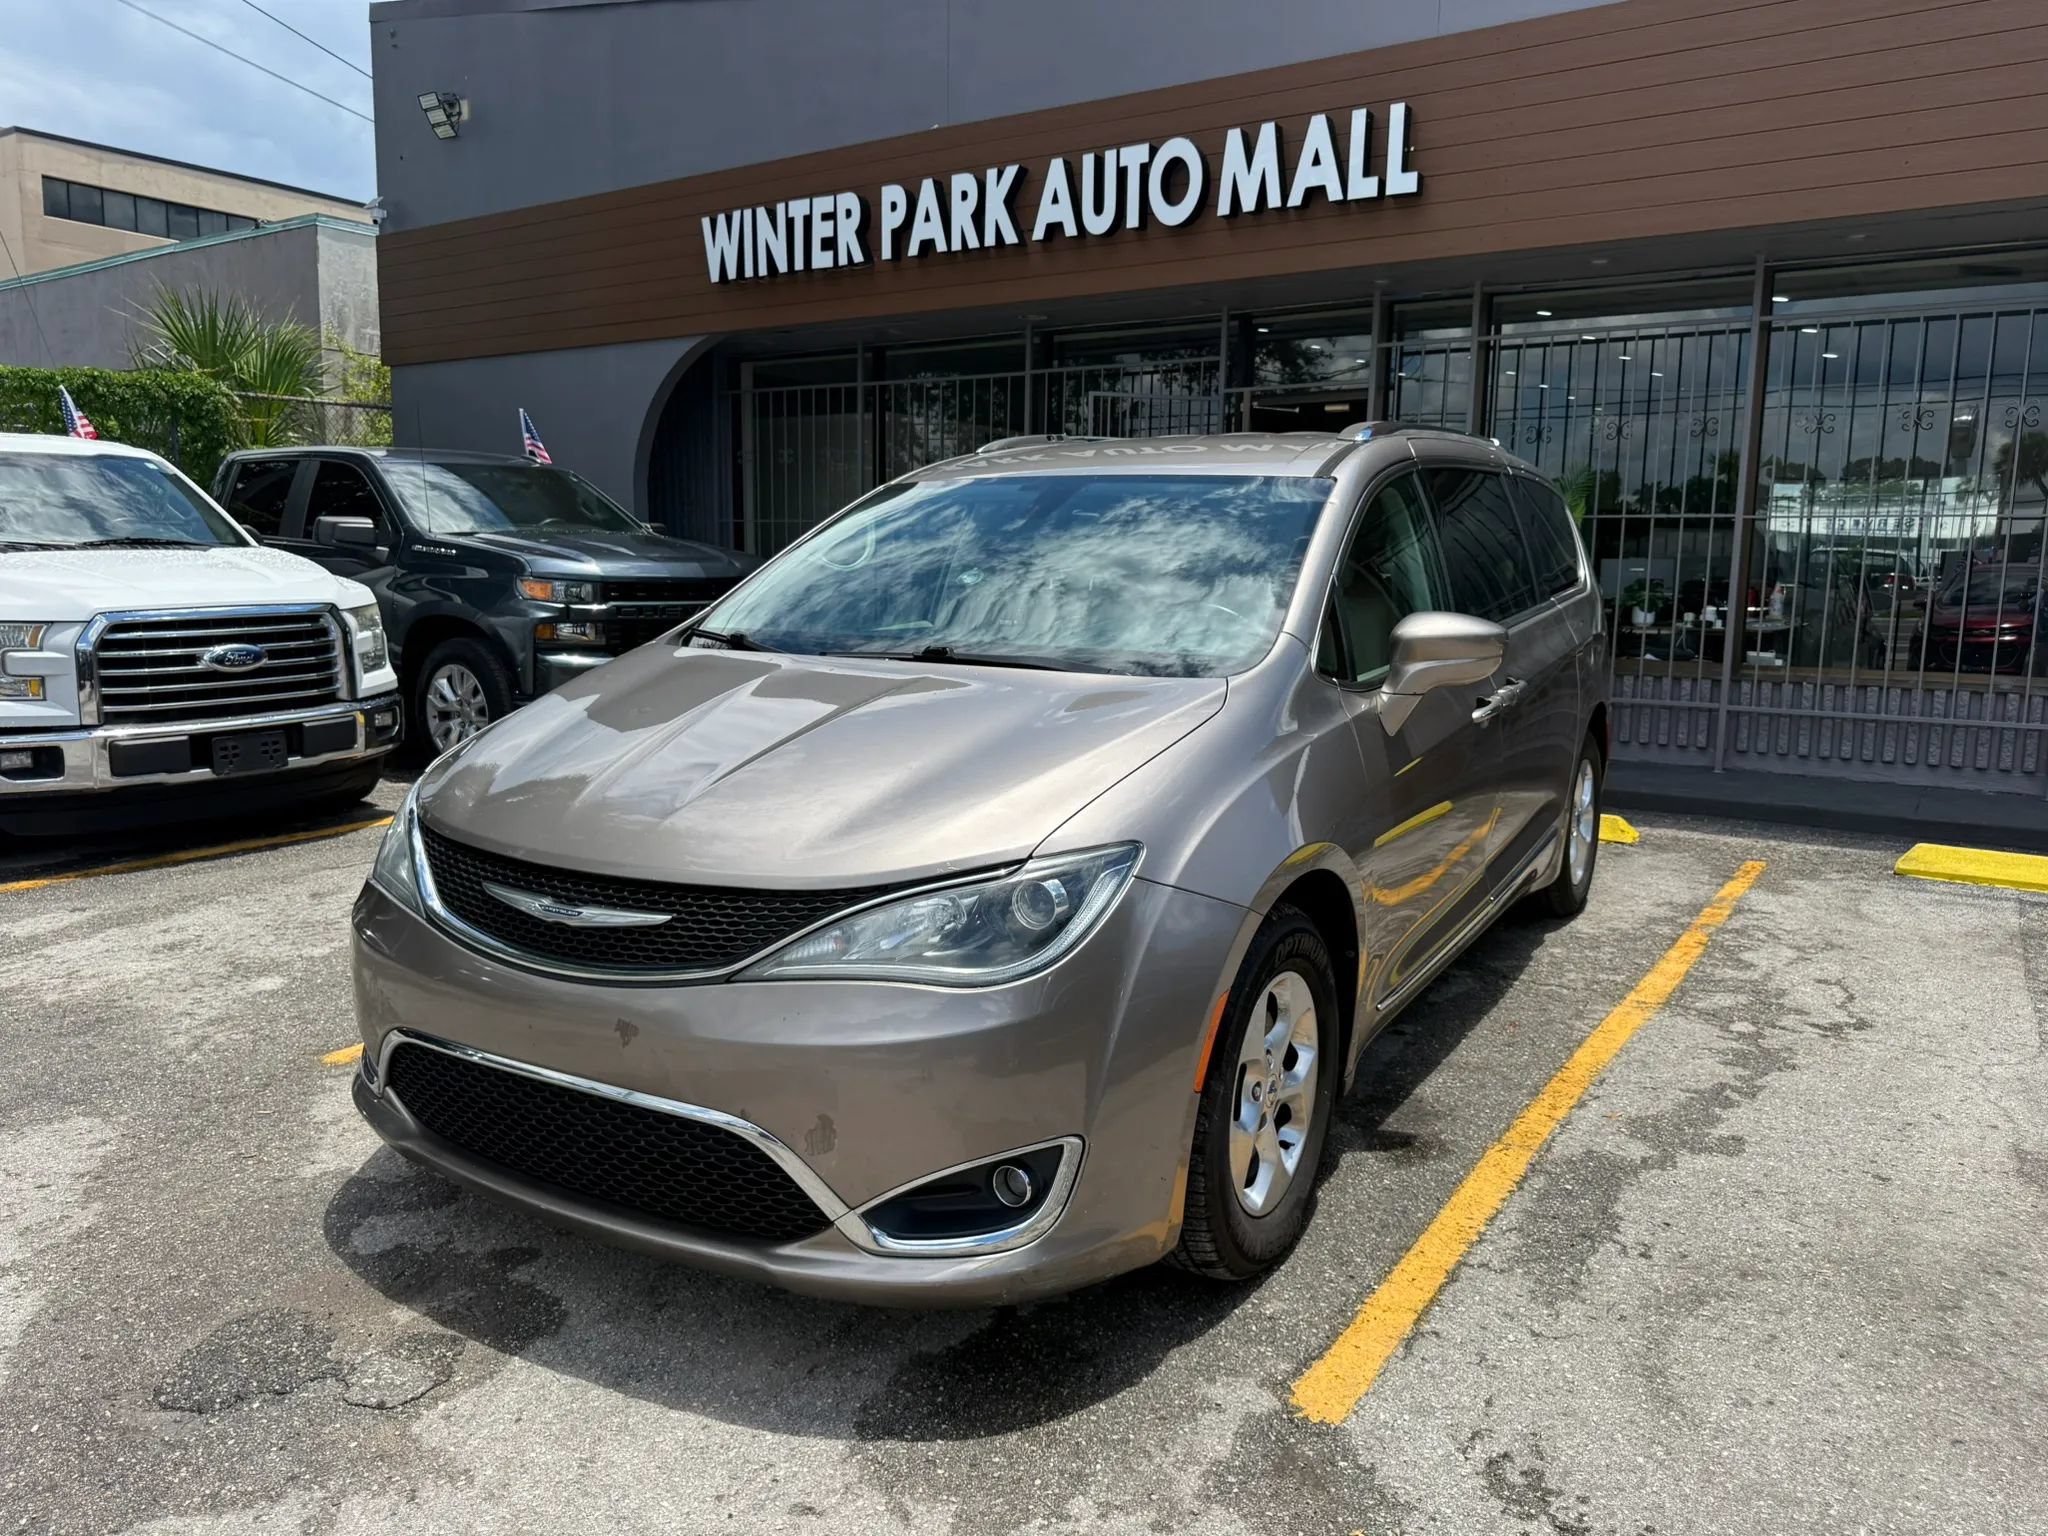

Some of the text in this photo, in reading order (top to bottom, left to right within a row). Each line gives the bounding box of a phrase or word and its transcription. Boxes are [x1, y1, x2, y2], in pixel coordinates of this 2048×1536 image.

[702, 102, 1418, 283] WINTER PARK AUTO MALL
